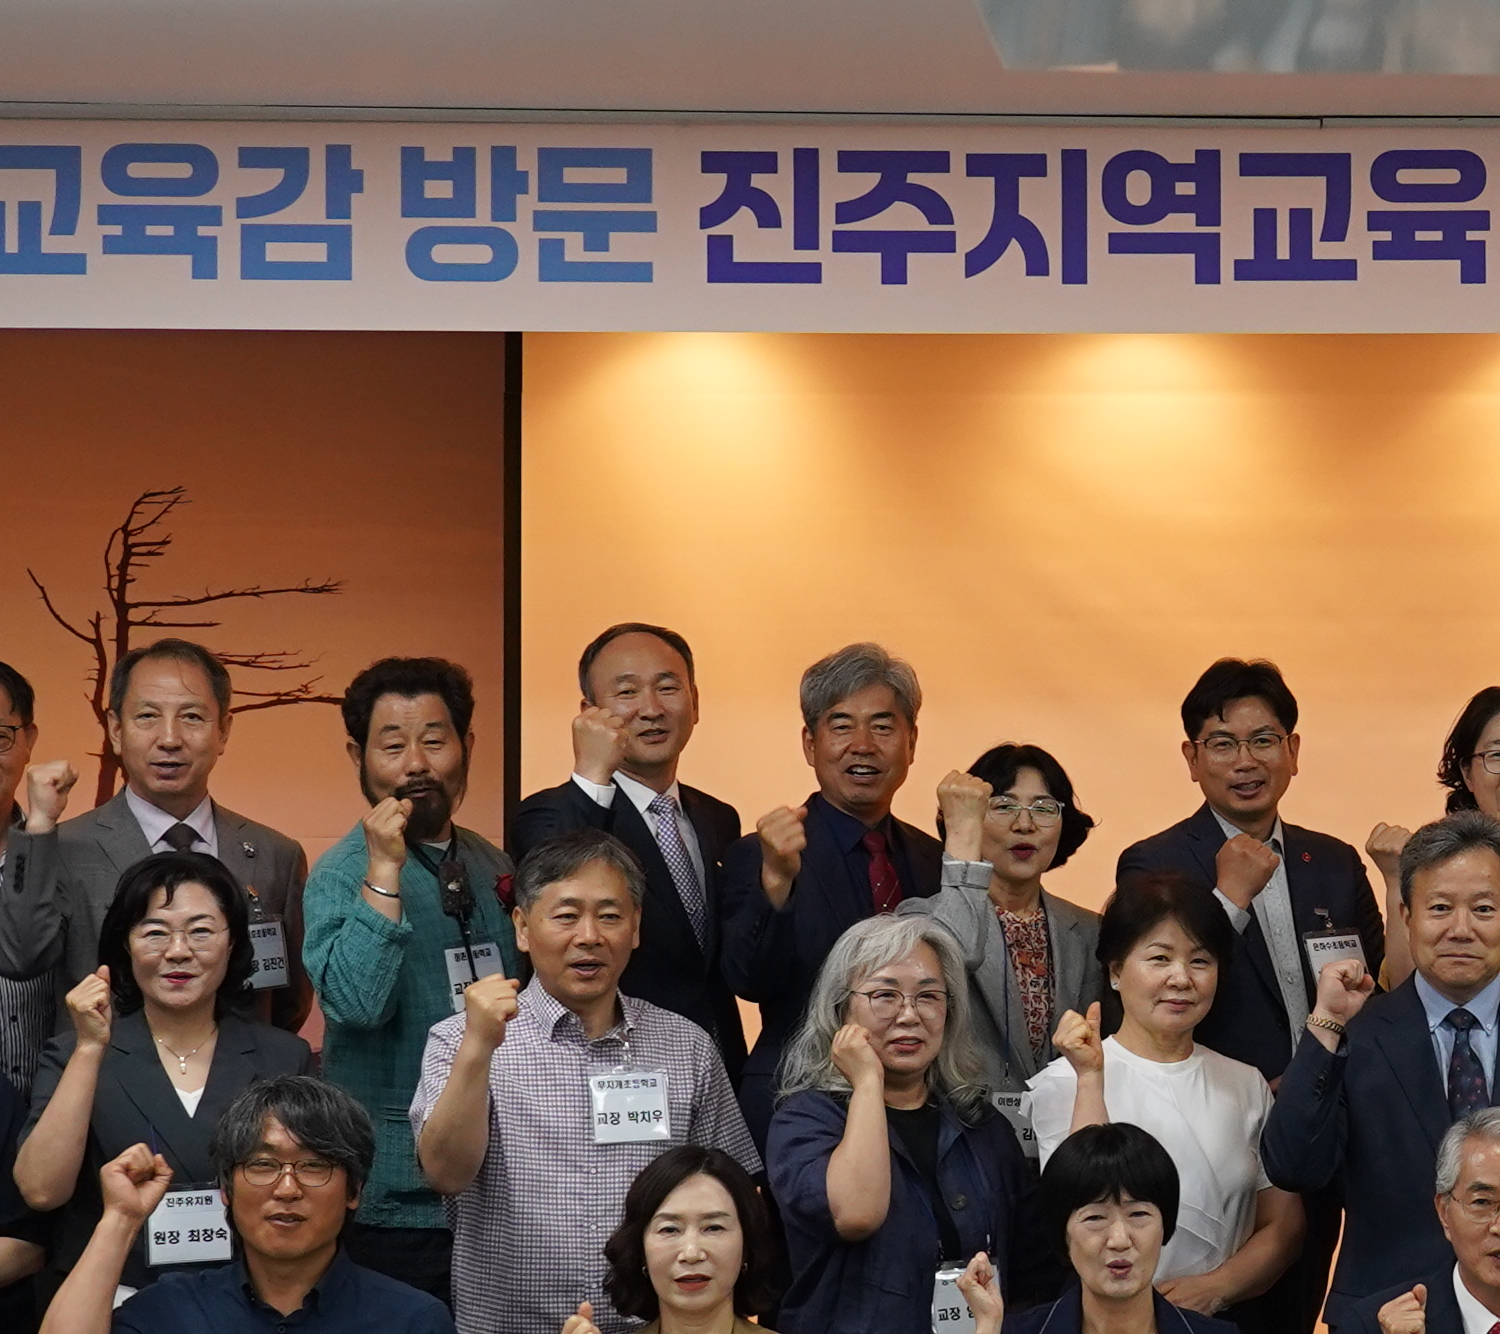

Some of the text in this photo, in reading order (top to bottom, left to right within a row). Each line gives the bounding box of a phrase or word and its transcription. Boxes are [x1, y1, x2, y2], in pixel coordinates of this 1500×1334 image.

[400, 145, 657, 282] 방문
[1313, 940, 1357, 952] 은하수초등학교
[454, 948, 492, 963] 정촌등학교
[598, 1079, 657, 1089] 무지개초등학교
[598, 1110, 662, 1125] 교장 박치우
[165, 1195, 213, 1208] 진주유치원
[154, 1231, 180, 1245] 원장
[938, 1307, 960, 1321] 교장
